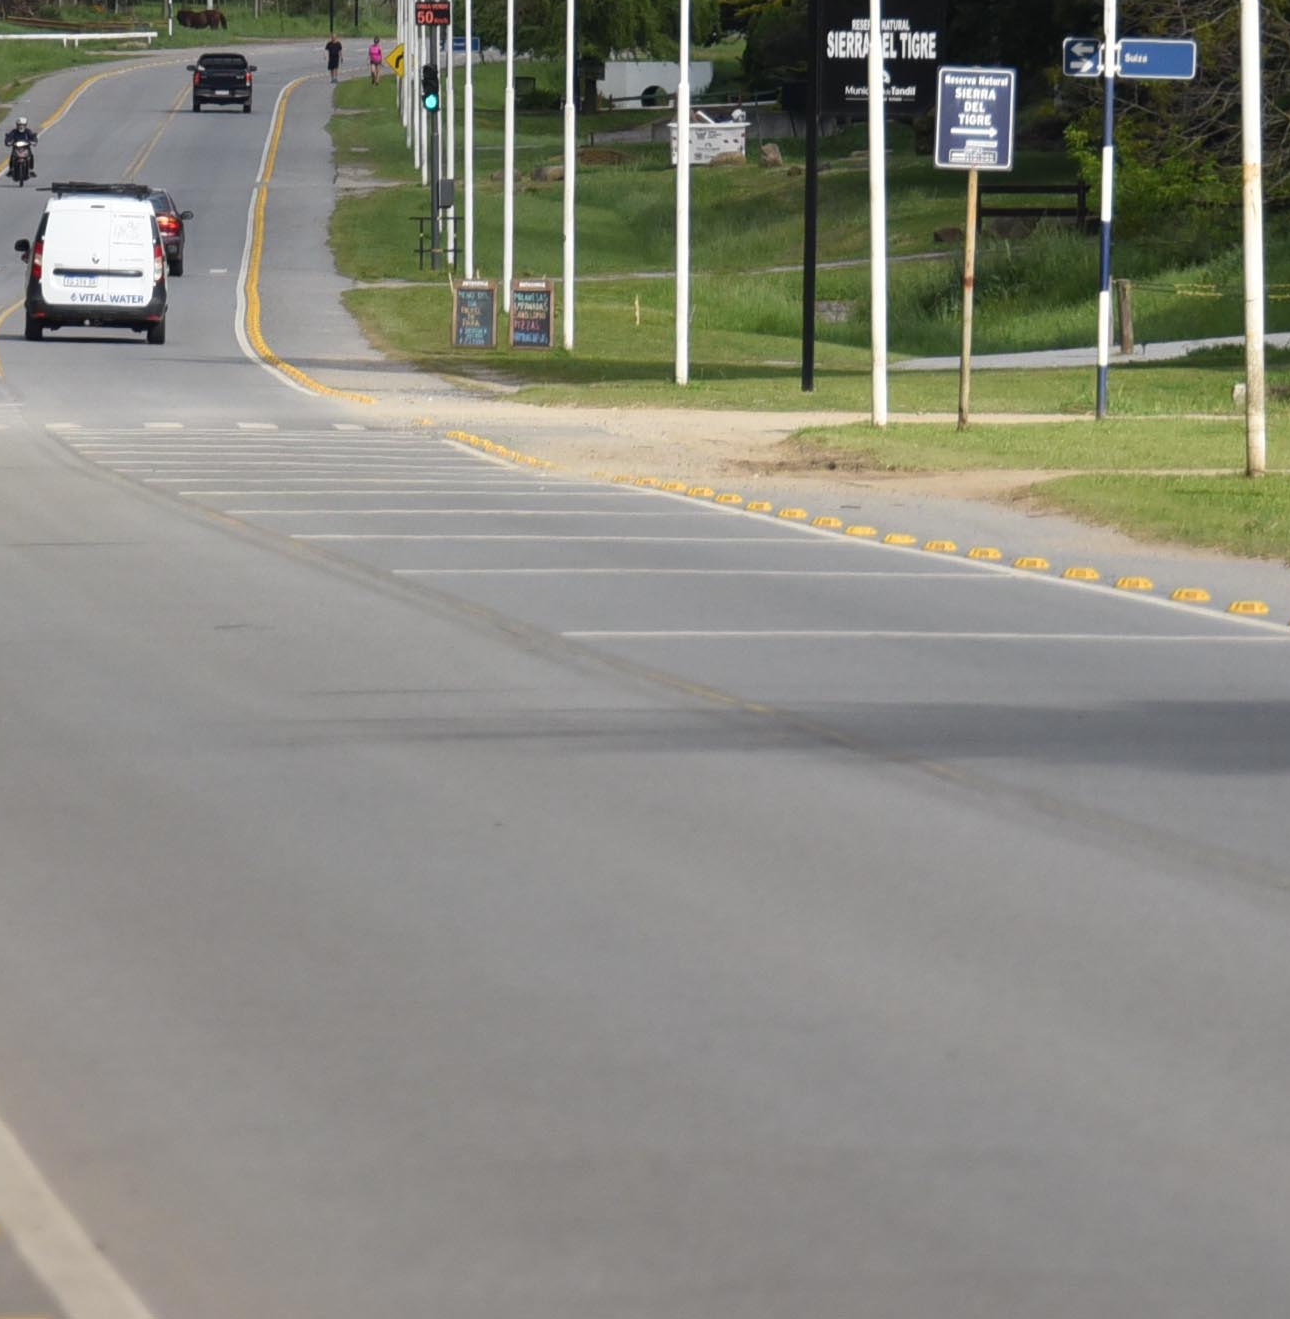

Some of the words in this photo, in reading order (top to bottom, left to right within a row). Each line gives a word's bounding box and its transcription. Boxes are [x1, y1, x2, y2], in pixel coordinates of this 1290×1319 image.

[417, 11, 434, 24] 50
[881, 32, 898, 59] EL
[899, 32, 937, 60] TIGRE
[891, 86, 916, 96] Tandil
[955, 87, 996, 100] SIERRA
[964, 101, 986, 113] DEL
[958, 113, 992, 126] TIGRE
[80, 293, 107, 303] VITAL
[109, 294, 144, 304] WATER
